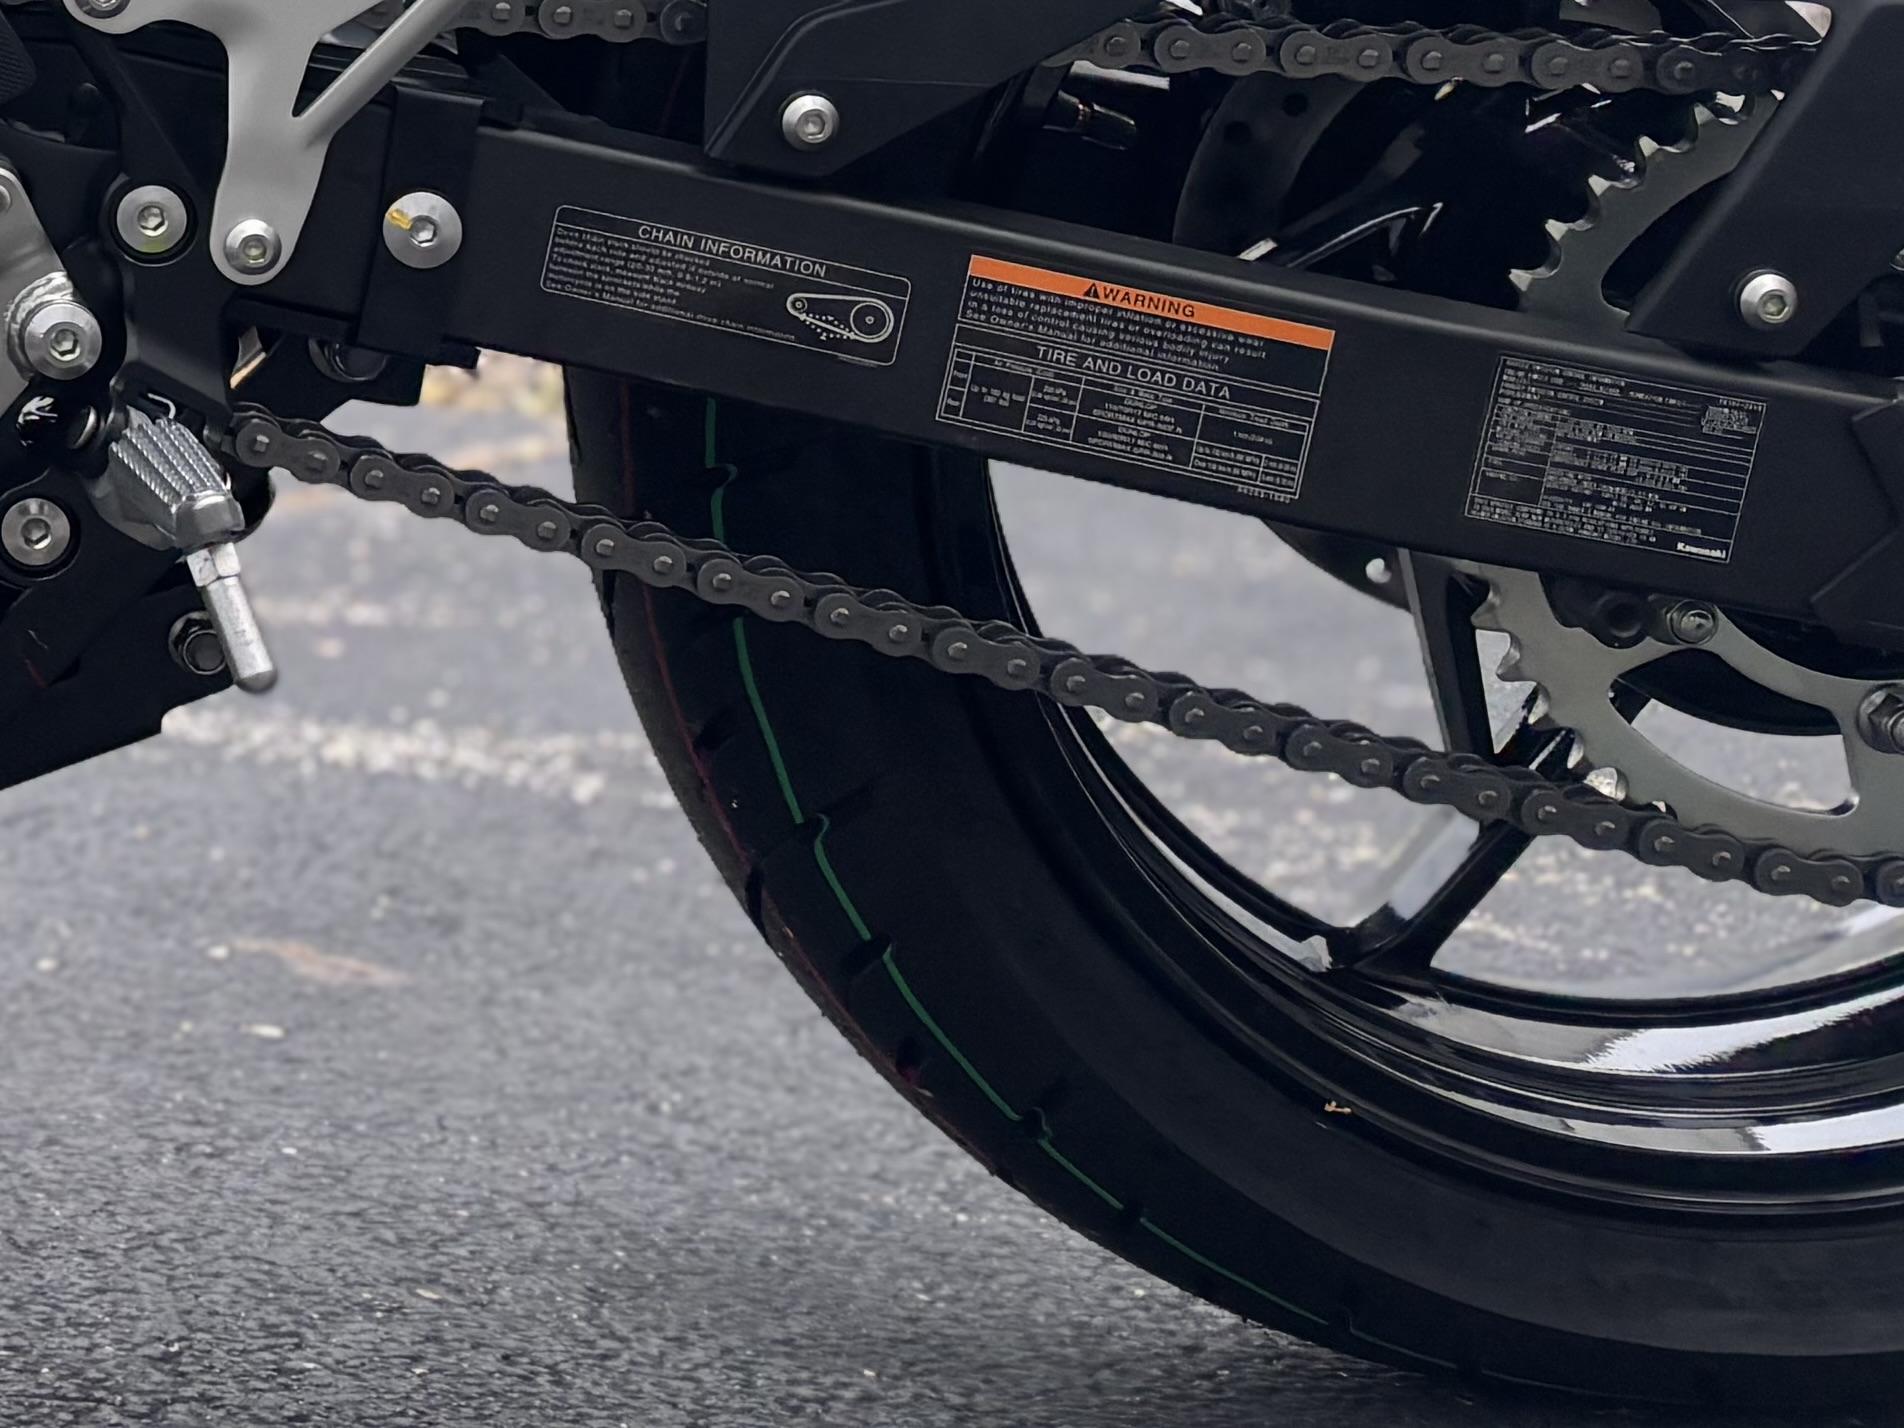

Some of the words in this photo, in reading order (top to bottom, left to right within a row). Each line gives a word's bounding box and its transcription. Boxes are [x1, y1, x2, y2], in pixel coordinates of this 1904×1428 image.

[637, 224, 694, 249] CHAIN
[699, 237, 827, 277] INFORMATION
[1101, 286, 1197, 318] WARNING
[1034, 345, 1077, 366] TIRE
[1082, 355, 1121, 375] AND
[1126, 365, 1176, 387] LOAD
[1182, 377, 1232, 399] DATA
